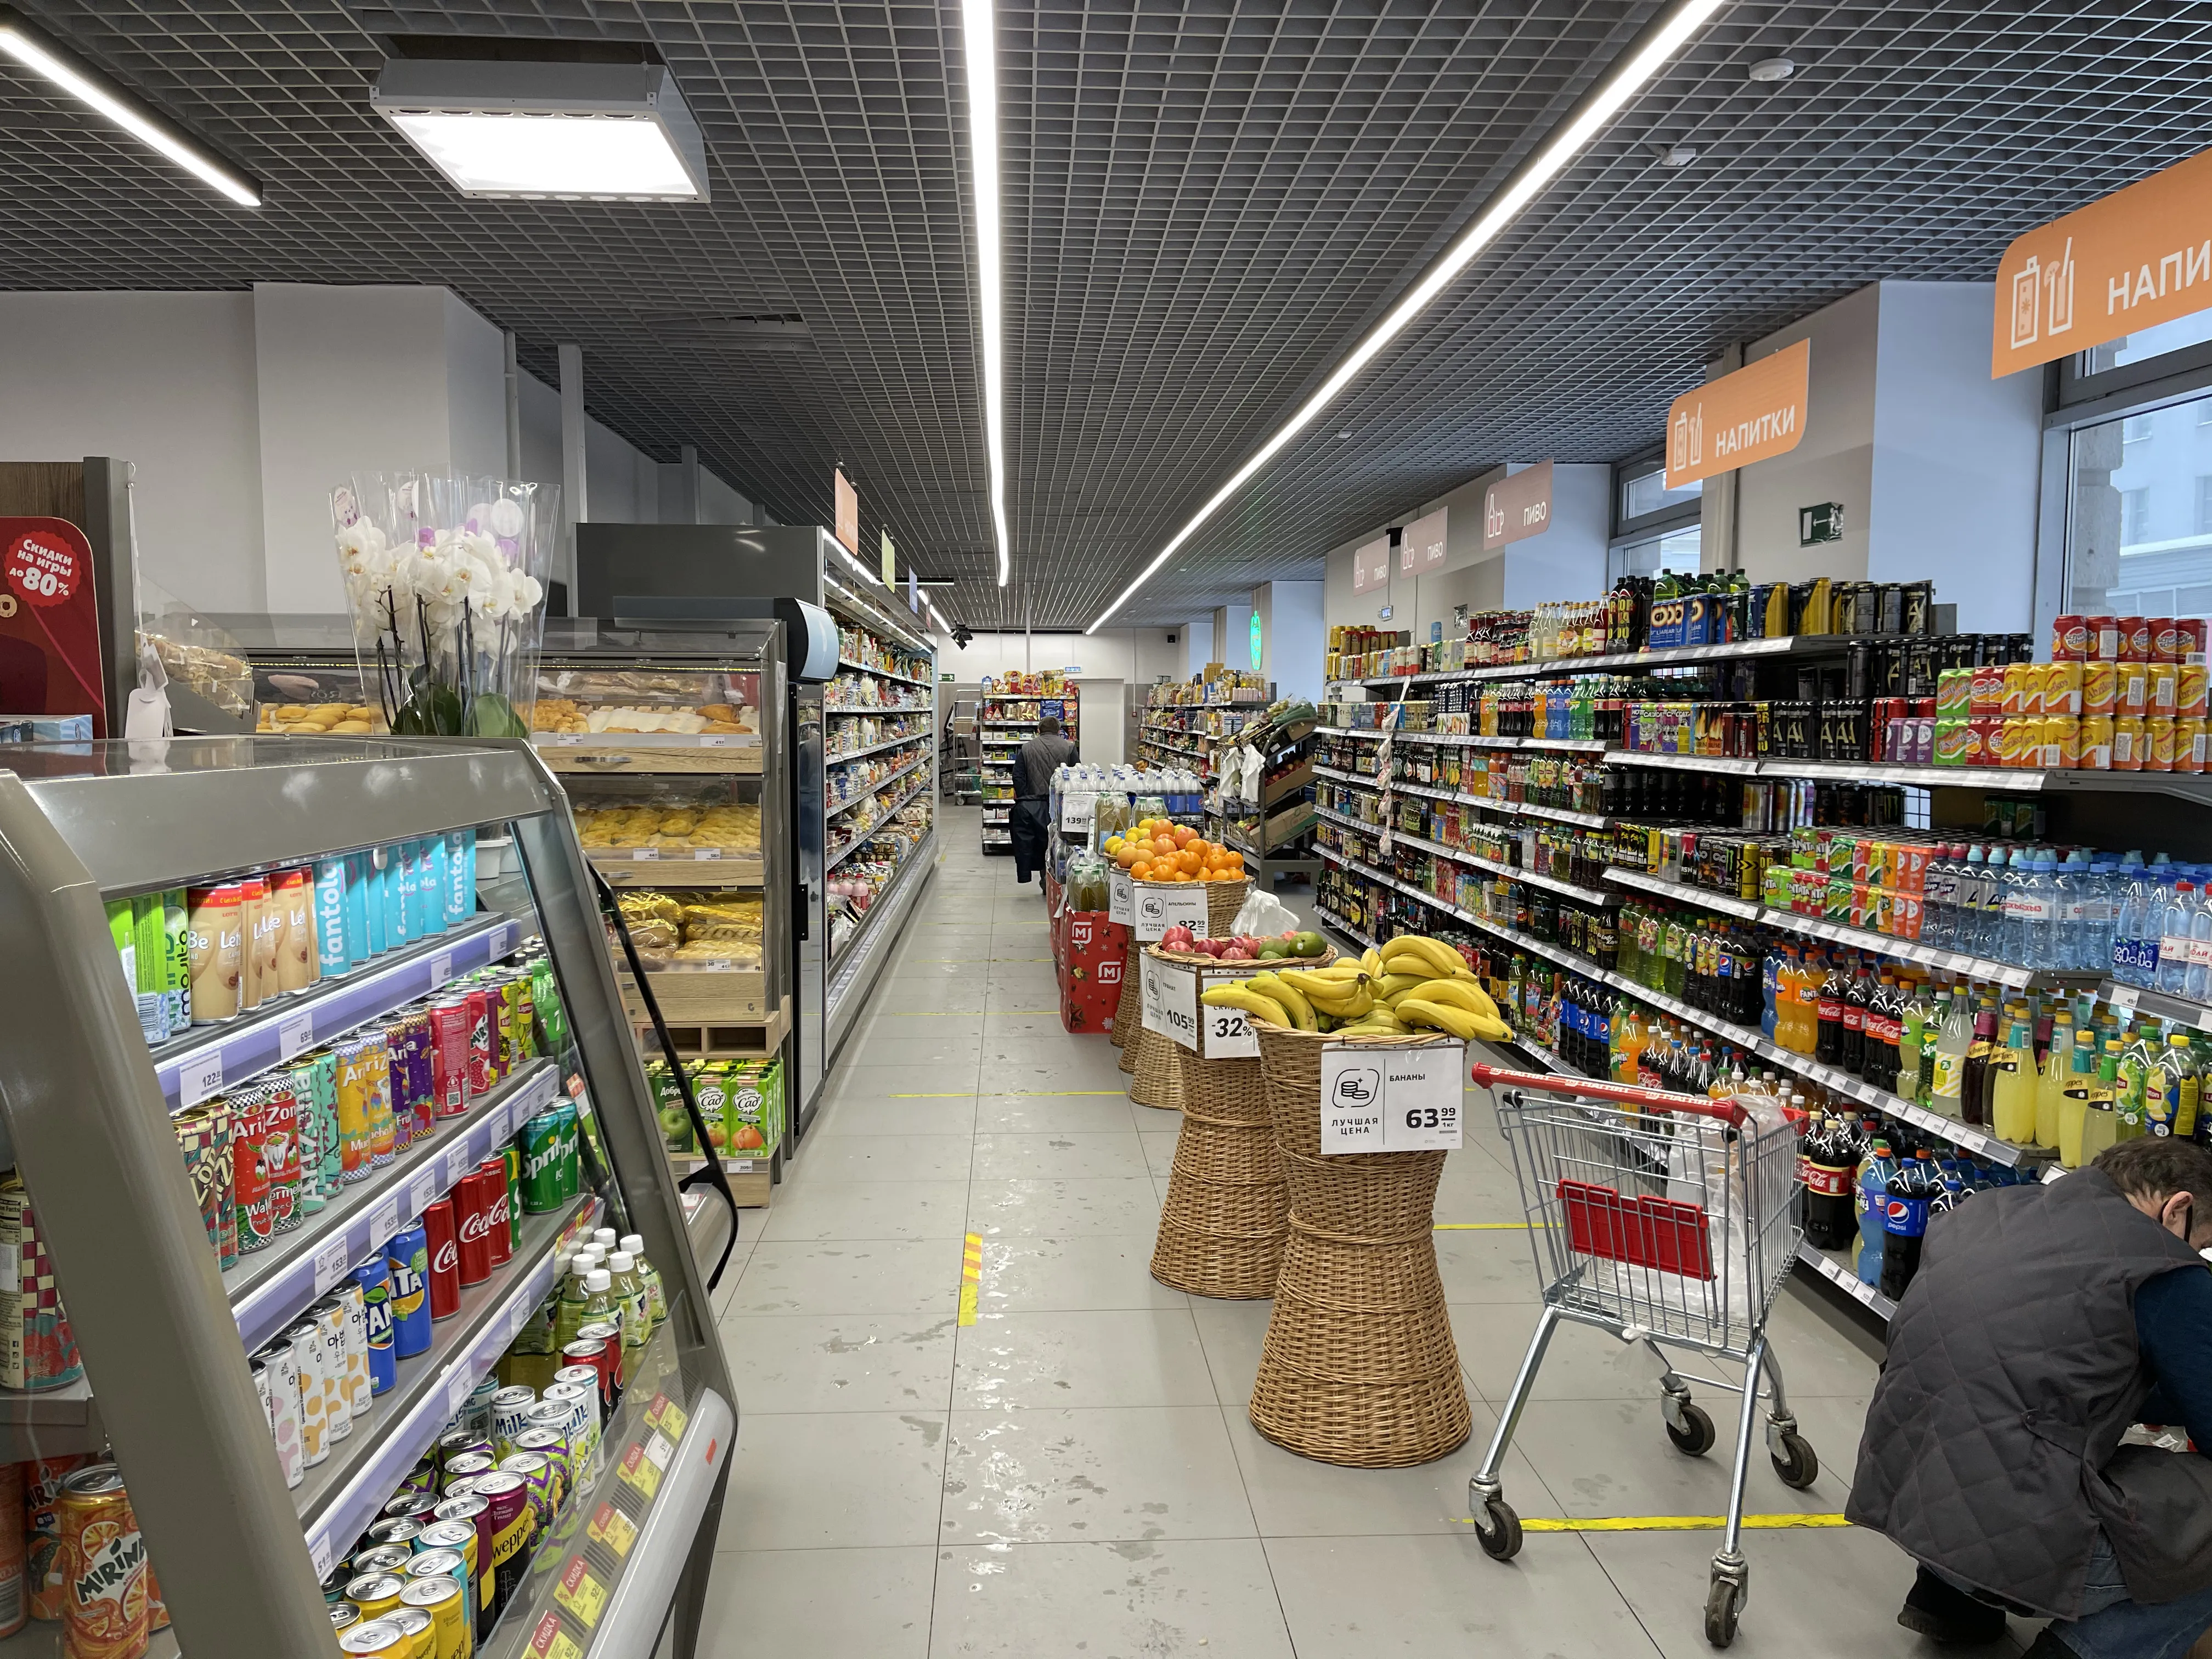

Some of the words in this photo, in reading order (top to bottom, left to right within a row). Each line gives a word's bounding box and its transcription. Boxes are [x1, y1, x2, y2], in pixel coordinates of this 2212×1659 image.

[2108, 239, 2211, 316] НАПИ
[1716, 405, 1795, 458] НАПИТКИ
[1524, 501, 1547, 527] ПИВО
[23, 539, 72, 566] Скидки
[1427, 541, 1443, 561] ПИВО
[16, 550, 34, 563] на
[37, 557, 72, 577] игры
[9, 567, 24, 577] до
[22, 567, 69, 596] 80%
[1374, 565, 1387, 582] ПИВО
[317, 862, 346, 966] fantola
[177, 930, 190, 1015] mojito
[1163, 981, 1176, 991] ГРАНАТ
[1146, 1003, 1164, 1017] ЛУЧШАЯ
[1150, 1011, 1162, 1021] ЦЕНА
[1167, 1010, 1188, 1029] 105
[1188, 1016, 1194, 1025] 99
[1211, 1017, 1252, 1037] -32%
[202, 1073, 216, 1087] 122
[1390, 1074, 1425, 1082] БАНАНЫ
[701, 1094, 723, 1107] Сад
[738, 1096, 760, 1109] Сад
[1332, 1118, 1378, 1127] ЛУЧШАЯ
[1406, 1108, 1439, 1129] 63
[1441, 1107, 1455, 1116] 99
[1340, 1126, 1369, 1135] ЦЕНА
[385, 1216, 394, 1231] 153
[1888, 1222, 1906, 1231] pepsi
[332, 1257, 343, 1272] 153
[627, 1447, 642, 1468] СКИДКА
[598, 1509, 611, 1528] СКИДКА
[76, 1536, 144, 1604] MIRIN
[566, 1560, 585, 1588] СКИДКА
[535, 1617, 557, 1649] СКИДКА
